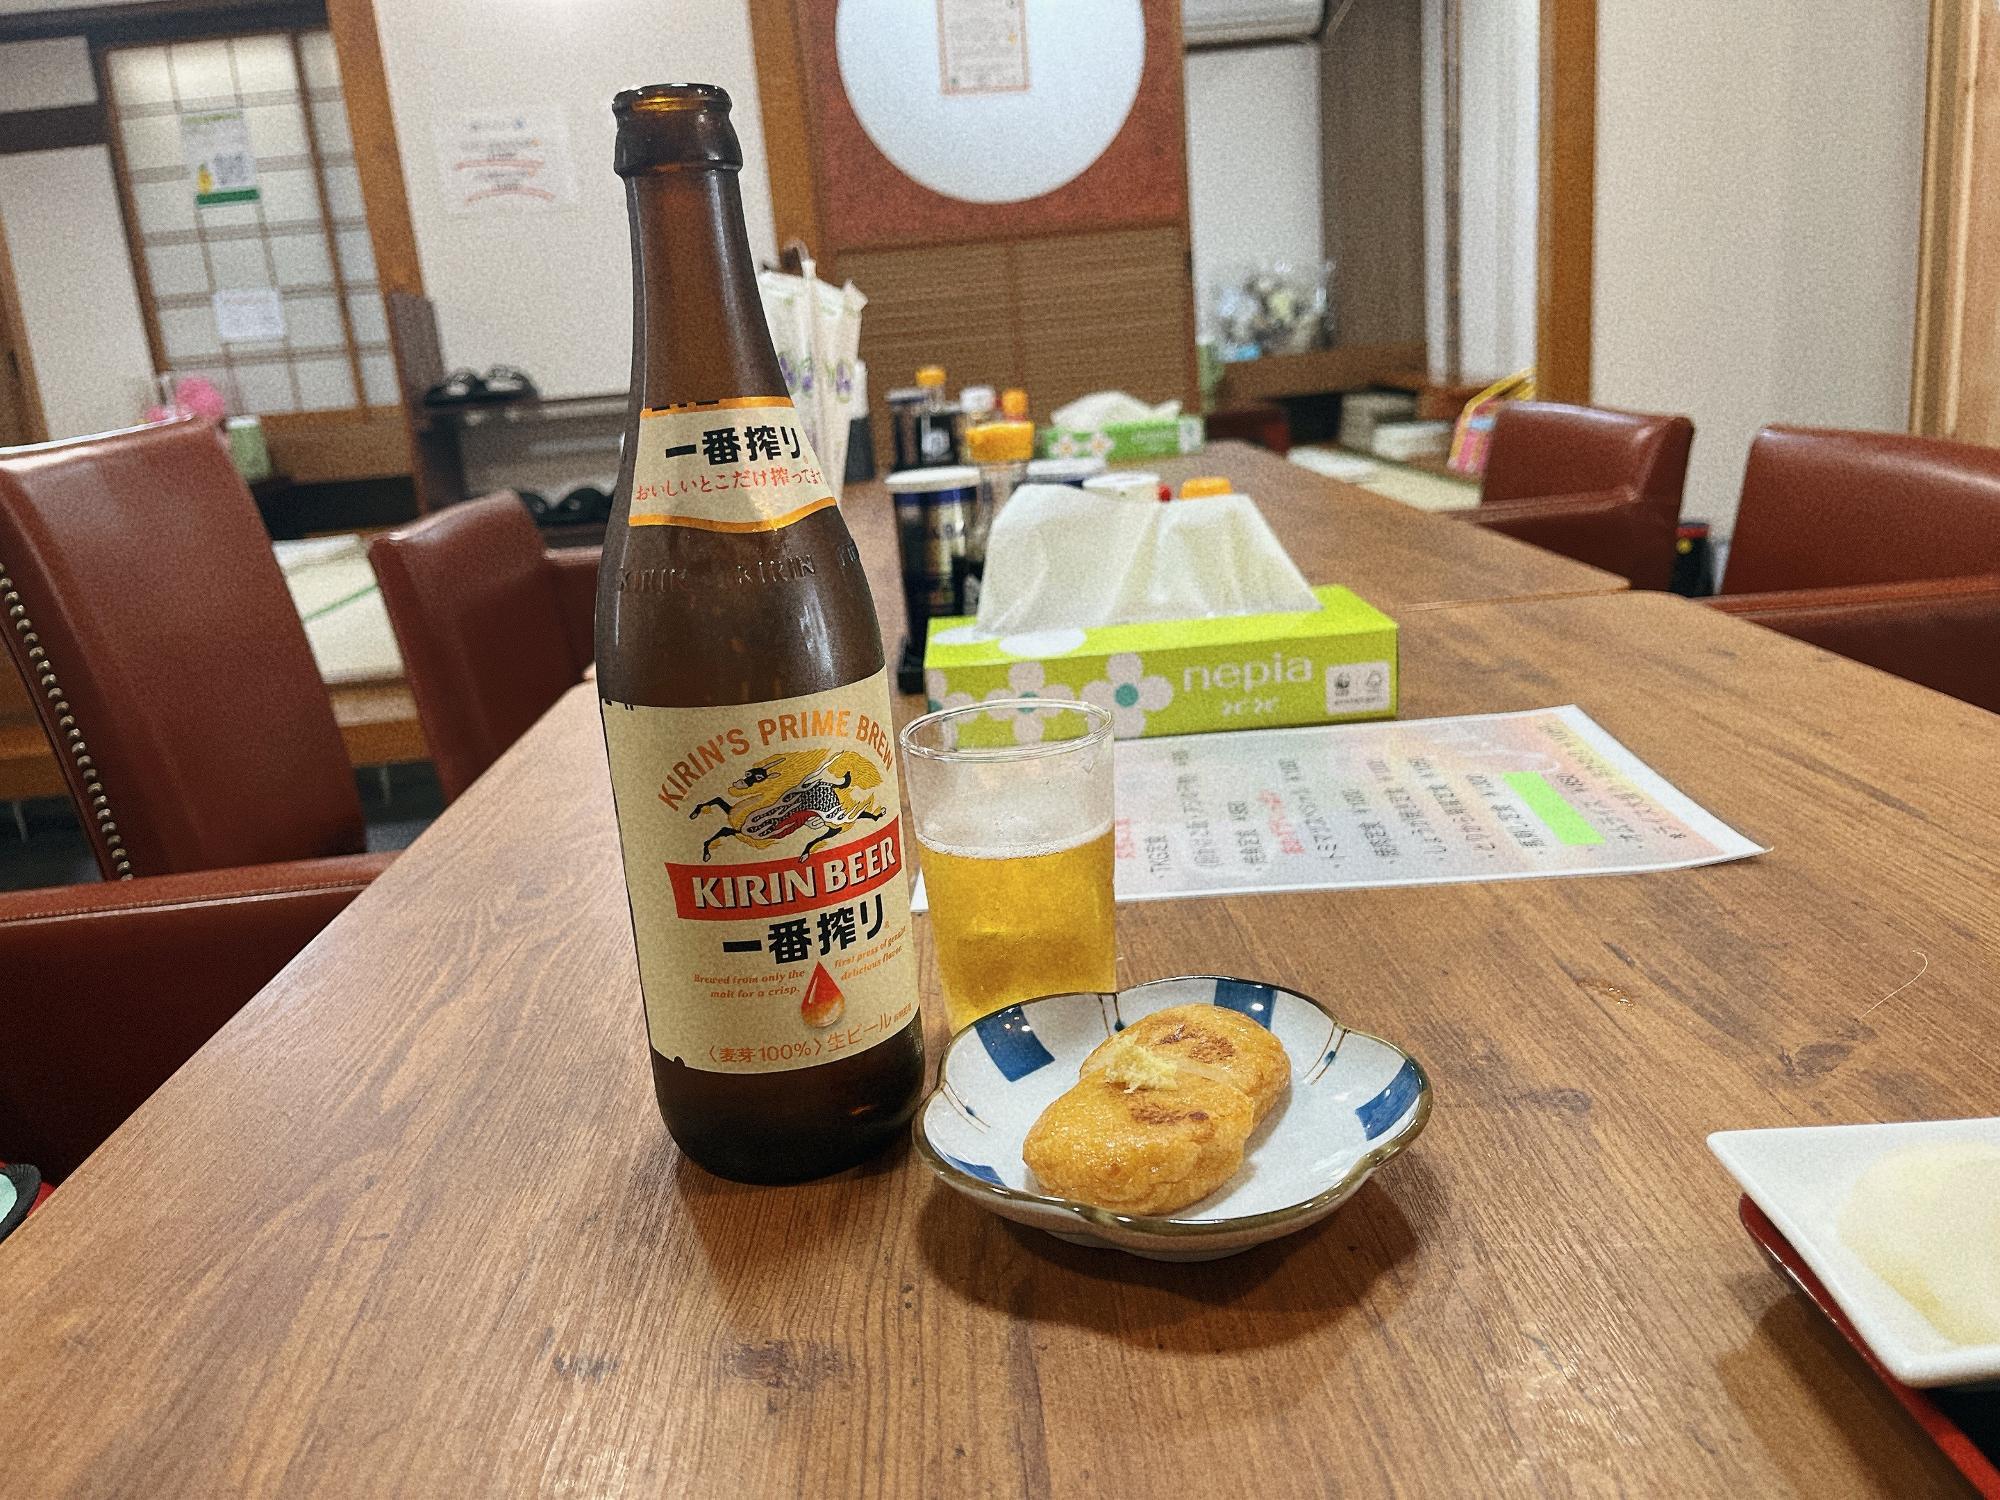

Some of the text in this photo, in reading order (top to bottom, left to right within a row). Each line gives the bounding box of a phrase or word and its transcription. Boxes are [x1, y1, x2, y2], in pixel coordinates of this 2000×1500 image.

[666, 425, 800, 466] 一番搾り
[1183, 651, 1313, 692] nepia
[658, 710, 893, 811] KIRIN'S PRIME BREW
[692, 836, 898, 910] KIRIN BEER
[722, 893, 885, 964] 一番搾り
[761, 972, 785, 983] only
[788, 968, 805, 979] the
